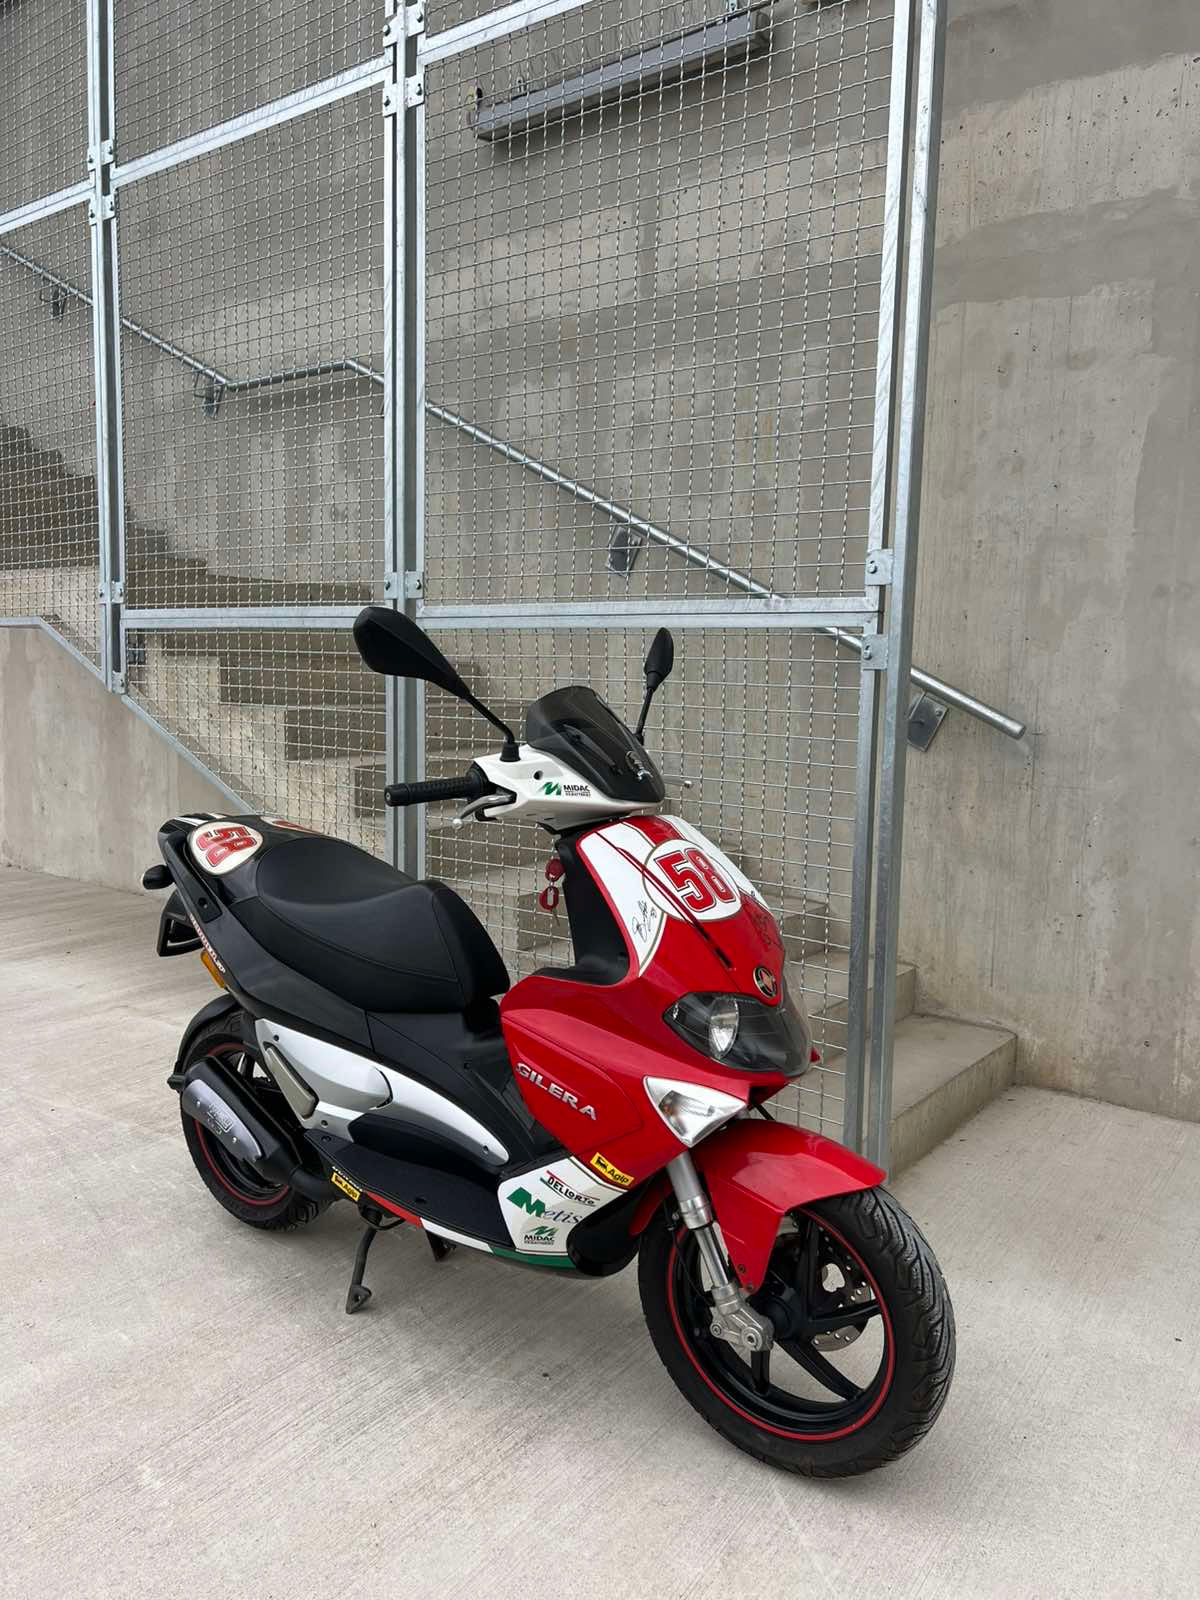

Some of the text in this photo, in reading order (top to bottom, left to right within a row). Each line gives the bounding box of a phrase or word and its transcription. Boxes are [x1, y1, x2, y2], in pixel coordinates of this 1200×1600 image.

[196, 826, 257, 867] 58
[653, 848, 736, 912] 58
[515, 1062, 597, 1121] GILERA
[607, 1168, 630, 1184] Agip
[506, 1187, 583, 1225] Metis
